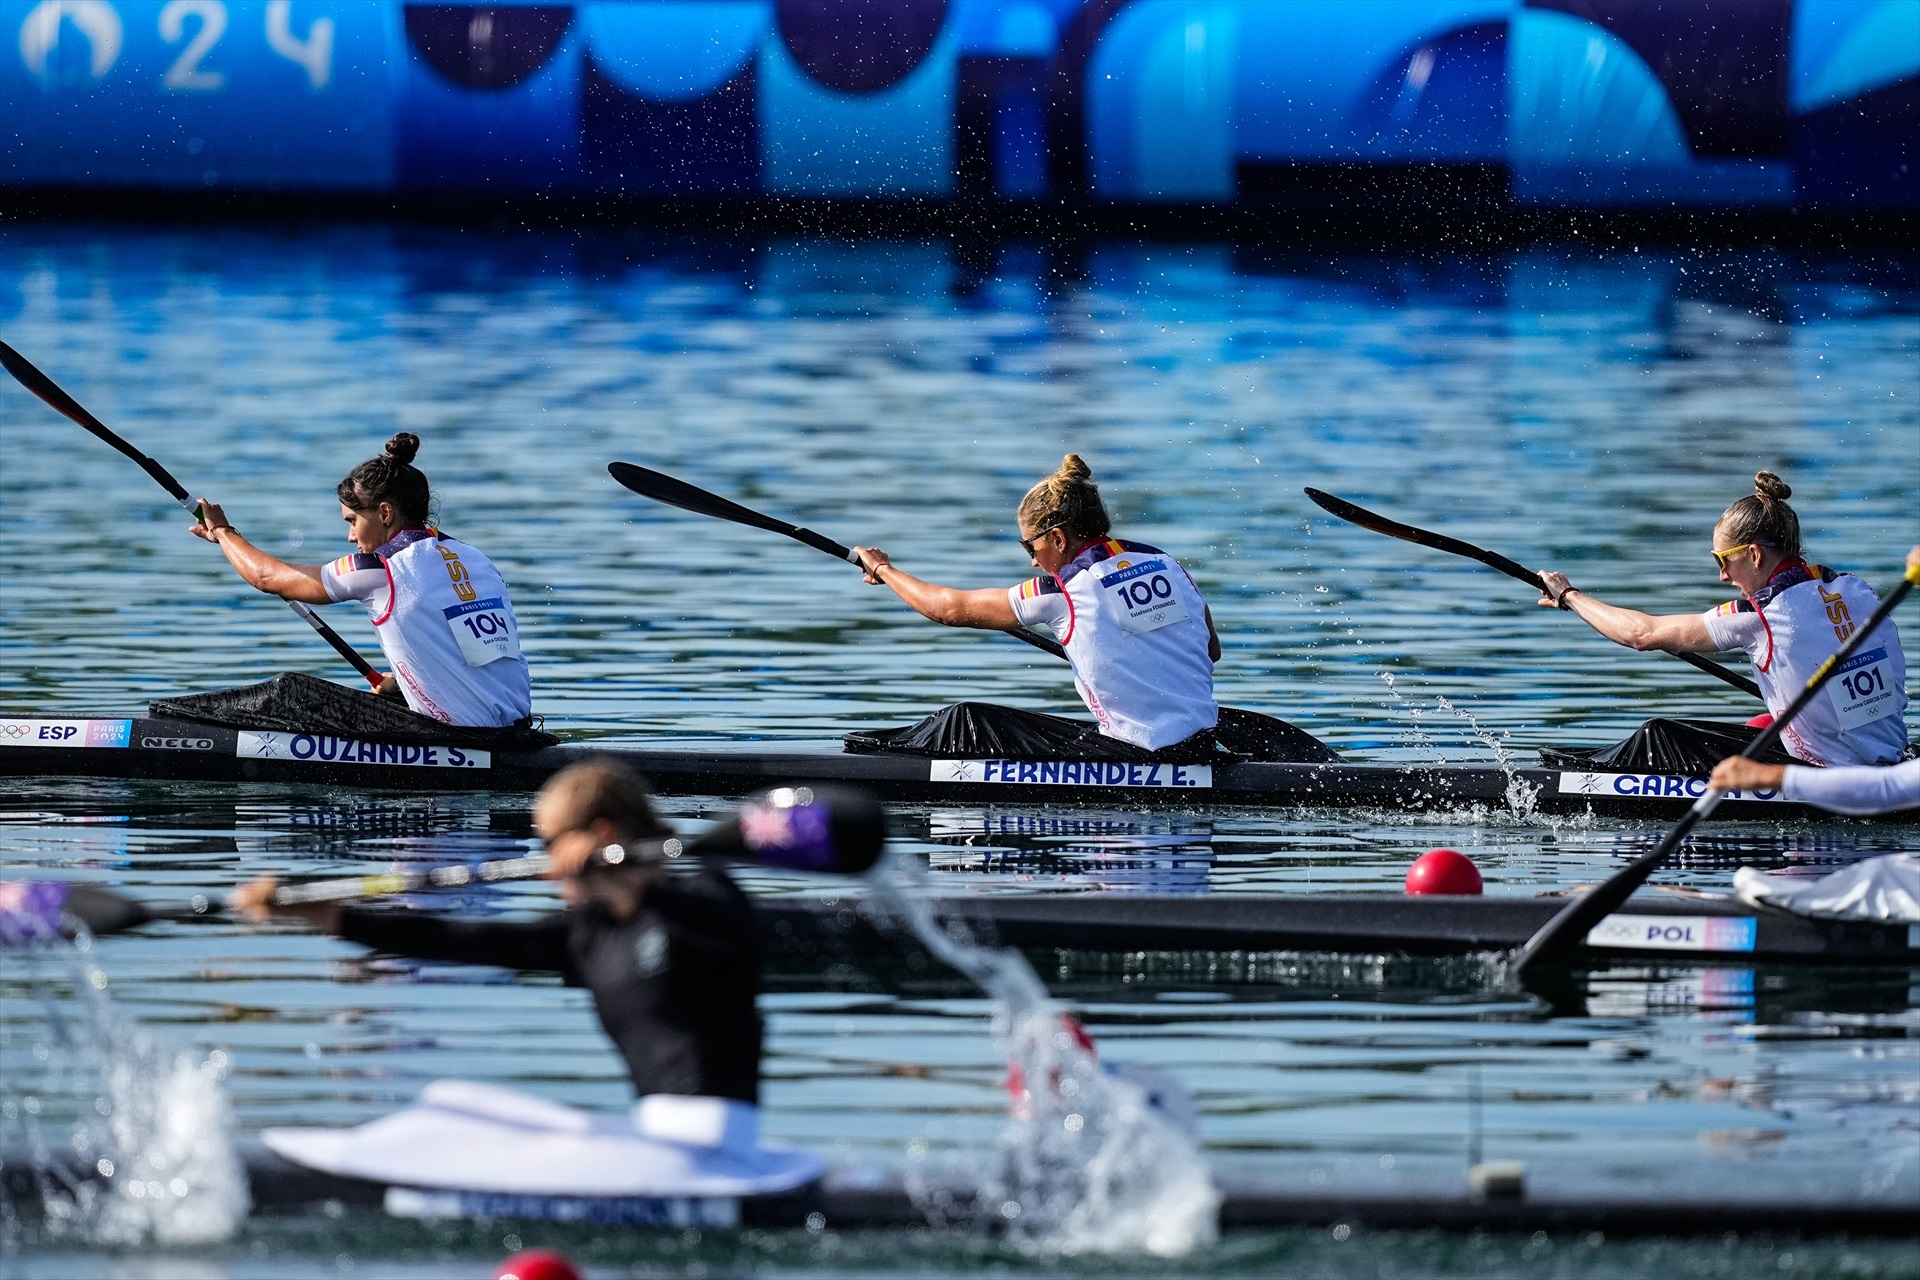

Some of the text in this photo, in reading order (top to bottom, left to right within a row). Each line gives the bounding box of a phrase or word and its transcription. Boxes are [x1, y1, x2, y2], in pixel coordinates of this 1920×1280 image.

[436, 544, 477, 602] ESP
[1118, 567, 1139, 581] PARIS
[1117, 574, 1172, 610] 100
[460, 603, 479, 612] PARIS
[1152, 599, 1177, 611] FERNANDEZ
[1817, 584, 1856, 644] ESP
[463, 612, 509, 639] 104
[1839, 661, 1858, 671] PARIS
[1841, 665, 1885, 701] 101
[38, 725, 78, 740] ESP
[93, 724, 125, 733] PARIS
[93, 732, 124, 741] 2024
[144, 738, 212, 750] NELO
[289, 734, 438, 766] OUZANDE
[983, 760, 1196, 787] FERNANDEZ E.
[1646, 925, 1696, 943] POL
